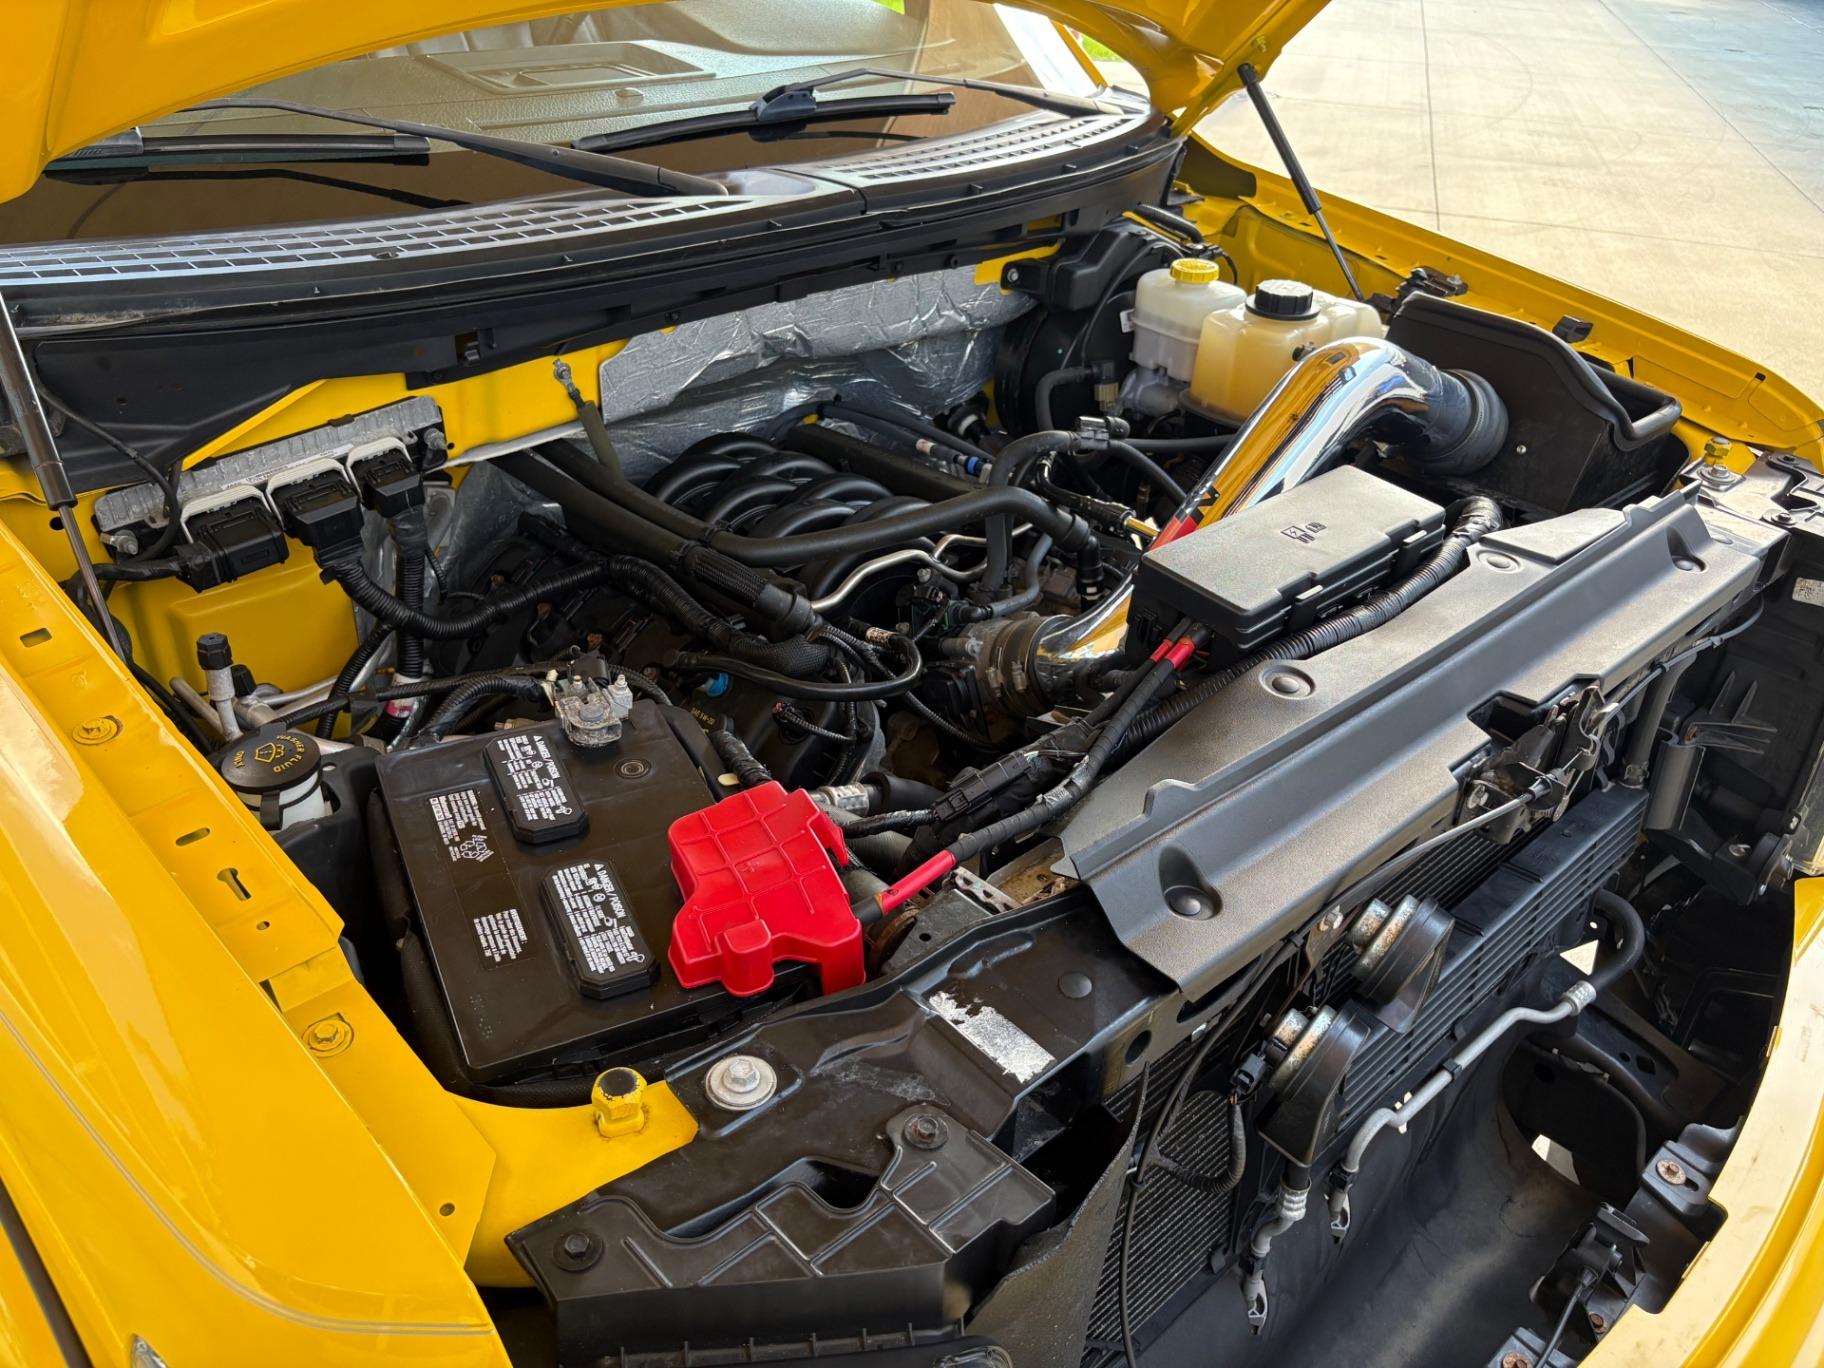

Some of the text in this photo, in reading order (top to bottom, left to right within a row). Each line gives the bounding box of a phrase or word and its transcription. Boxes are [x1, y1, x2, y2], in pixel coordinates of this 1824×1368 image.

[233, 750, 246, 768] ONLY
[273, 735, 305, 773] WASHER FLUID
[596, 869, 615, 893] DANGER
[608, 896, 627, 919] POISON
